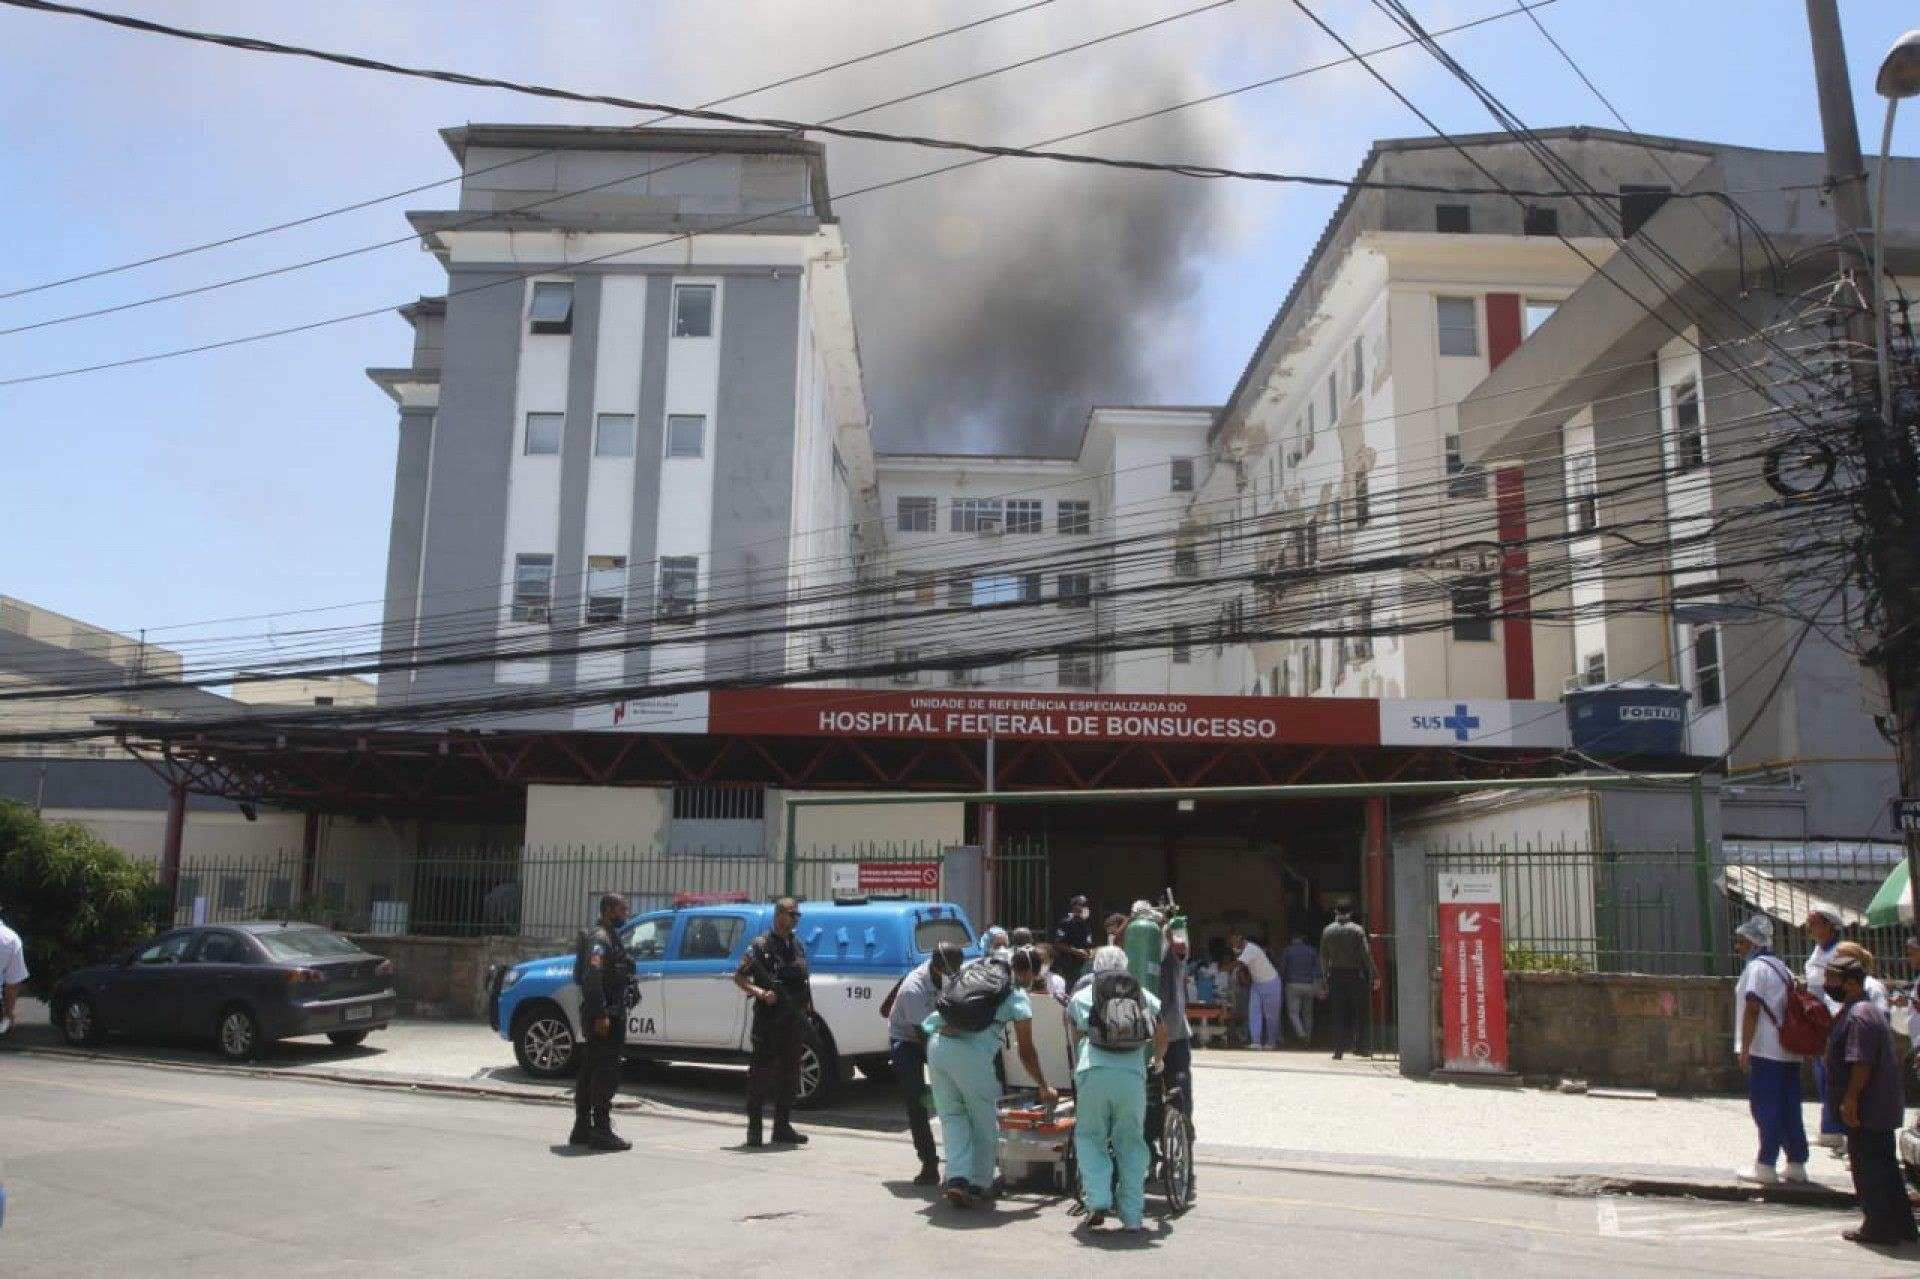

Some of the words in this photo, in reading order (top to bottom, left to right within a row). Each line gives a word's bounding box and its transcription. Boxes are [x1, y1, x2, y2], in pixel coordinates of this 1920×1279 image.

[911, 698, 966, 709] UNIDADE
[969, 699, 985, 709] DE
[989, 697, 1067, 711] REFERÊNCIA
[1069, 700, 1165, 712] ESPECIALIZADA
[1168, 702, 1187, 713] DO
[819, 711, 939, 732] HOSPITAL
[947, 713, 1060, 734] FEDERAL
[1067, 716, 1100, 735] DE
[1106, 716, 1276, 738] BONSUCESSO
[1412, 716, 1441, 729] SUS
[847, 987, 872, 999] 190
[629, 1017, 656, 1034] CIA
